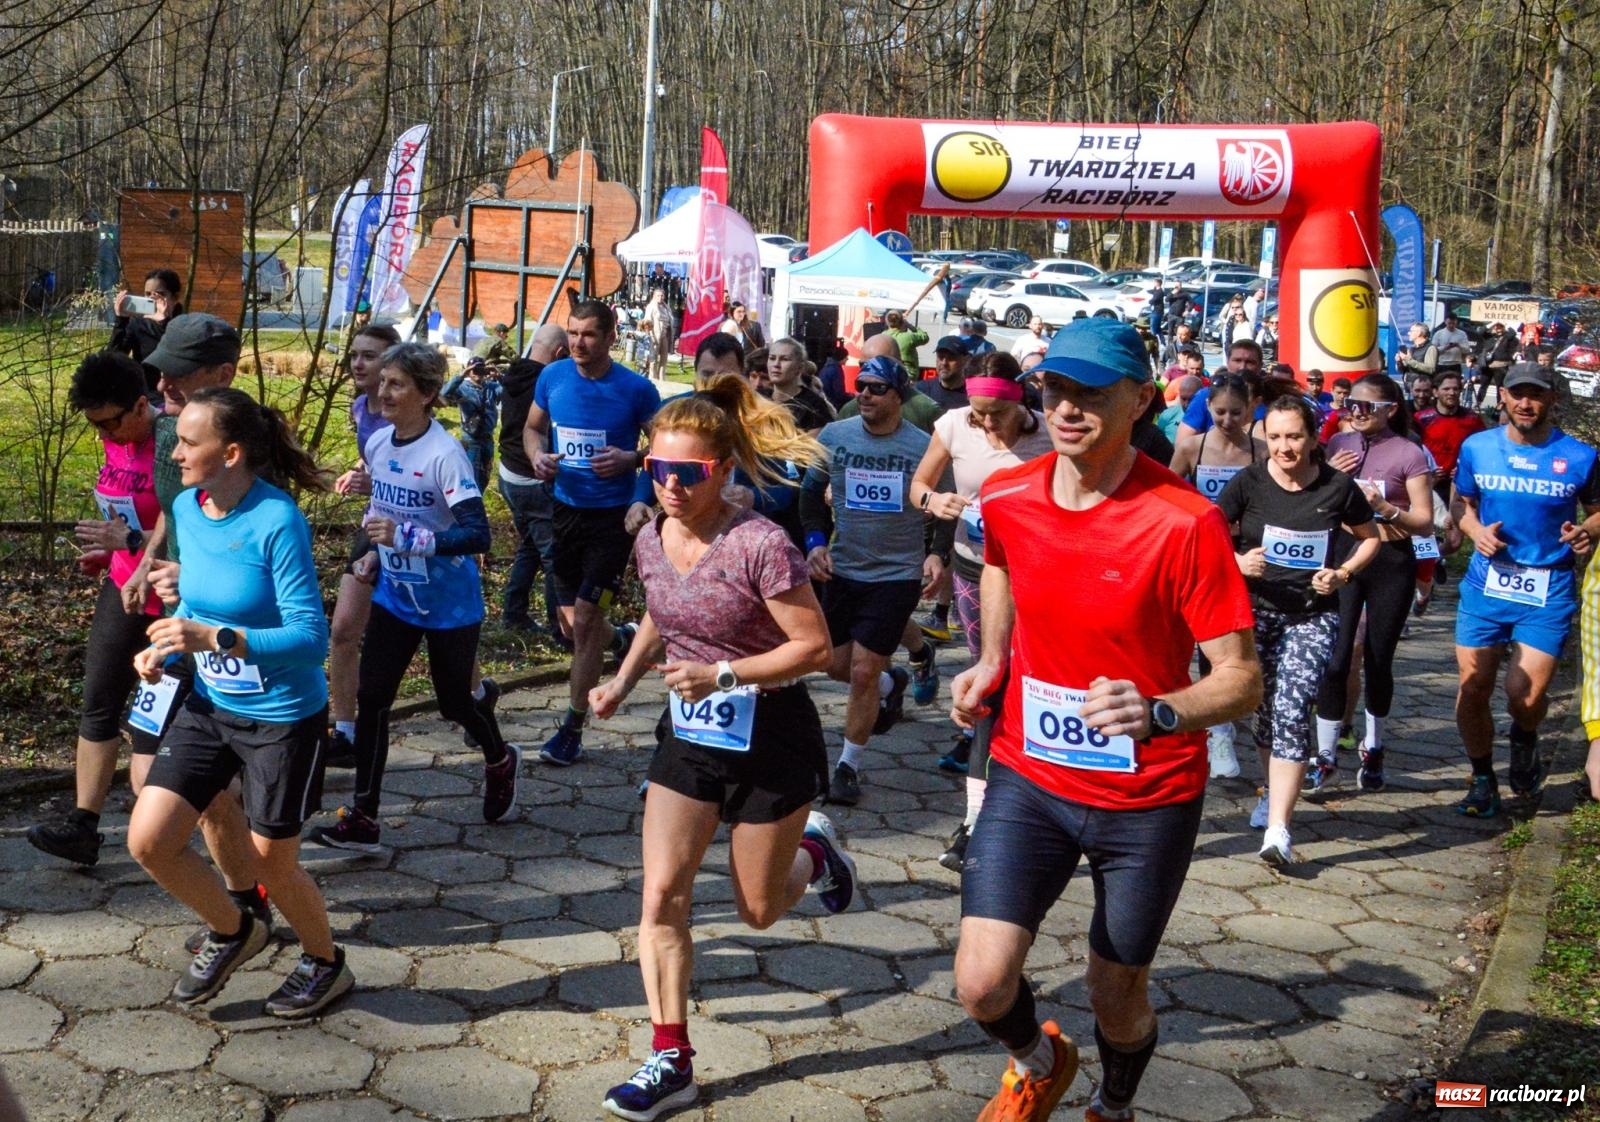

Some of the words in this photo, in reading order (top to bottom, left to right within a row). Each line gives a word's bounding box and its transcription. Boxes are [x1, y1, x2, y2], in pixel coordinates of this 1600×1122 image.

[1079, 135, 1141, 150] BIEG
[1029, 159, 1195, 180] TWARDZIELA
[1041, 186, 1176, 206] RACIBÓRZ
[566, 442, 594, 458] 019
[833, 446, 913, 473] CrossFit
[371, 479, 434, 507] NNERS
[855, 484, 891, 501] 069
[1205, 479, 1229, 493] 07
[1474, 474, 1576, 497] RUNNERS
[1273, 541, 1315, 558] 068
[1498, 573, 1536, 593] 036
[681, 699, 736, 728] 049
[1039, 711, 1110, 748] 086
